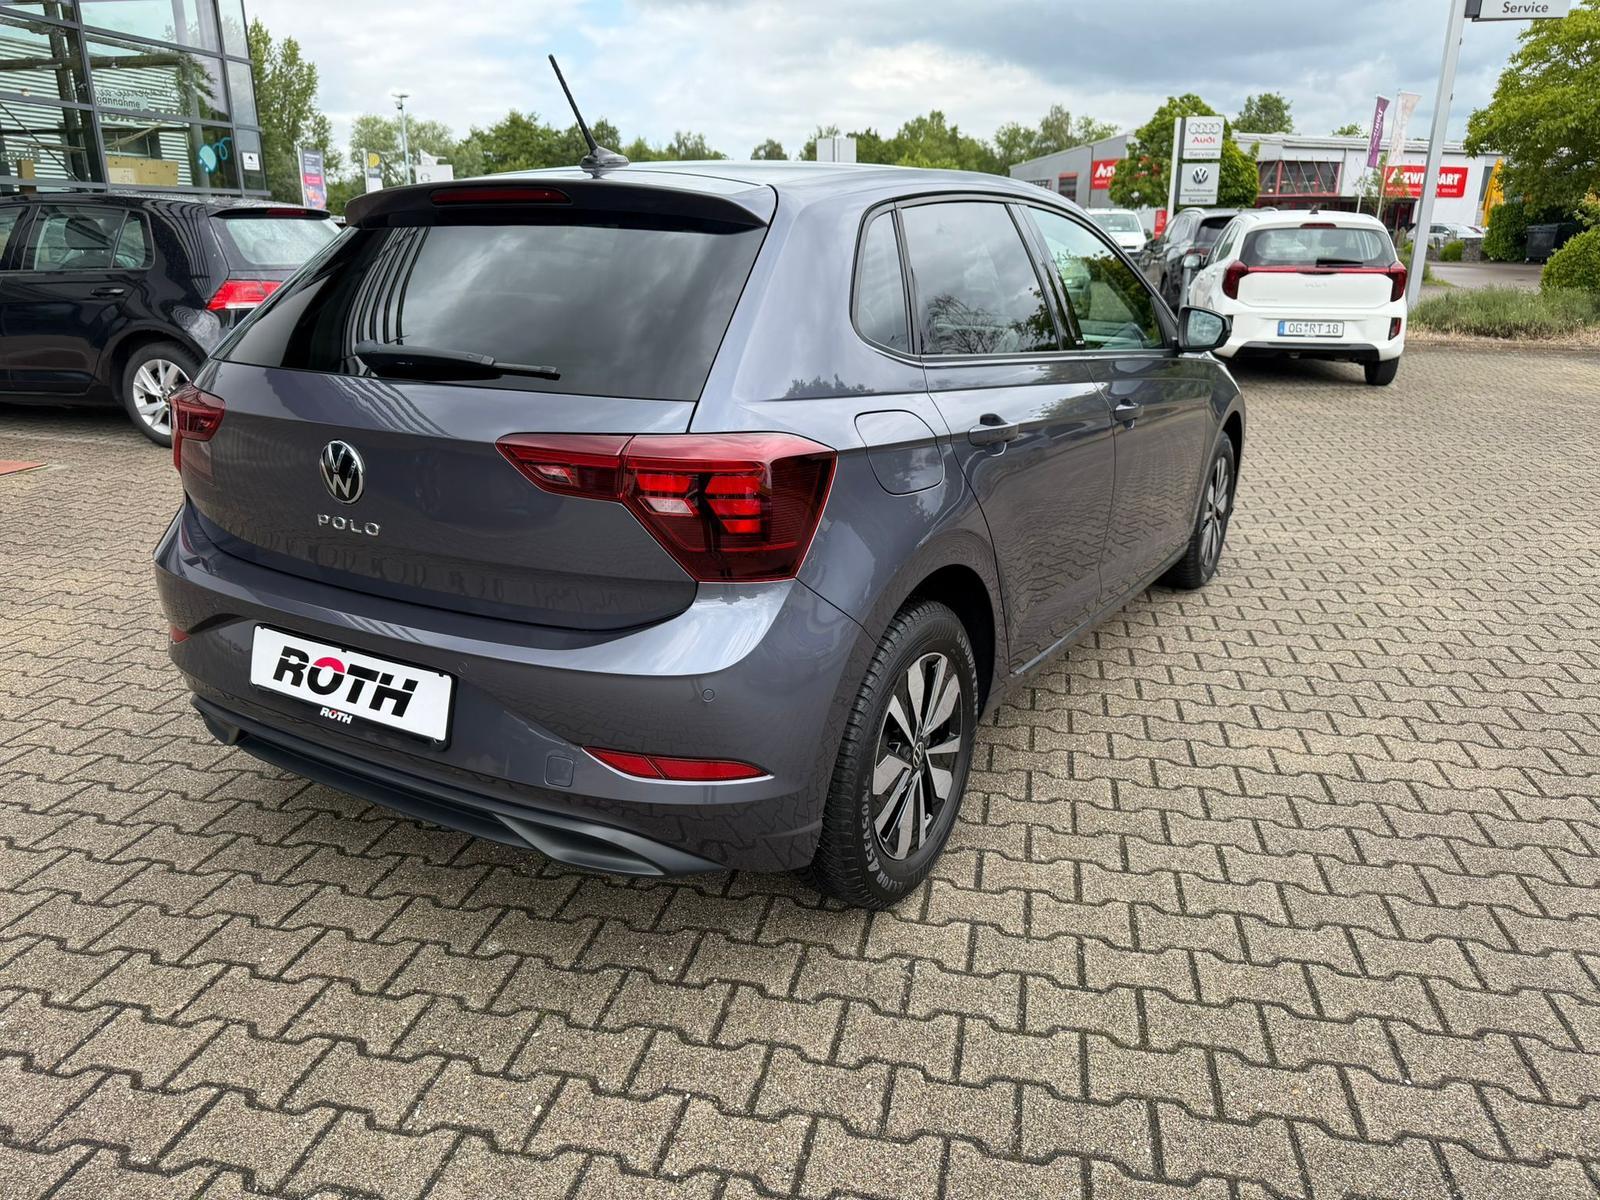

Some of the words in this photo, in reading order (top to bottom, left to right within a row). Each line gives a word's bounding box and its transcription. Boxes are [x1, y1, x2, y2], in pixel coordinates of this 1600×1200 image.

[1502, 1, 1549, 13] Service
[1192, 136, 1216, 144] Audi
[1288, 322, 1303, 334] OG
[1326, 322, 1339, 334] 18
[316, 513, 382, 537] POLO
[272, 645, 420, 718] ROTH
[320, 706, 353, 724] ROTH
